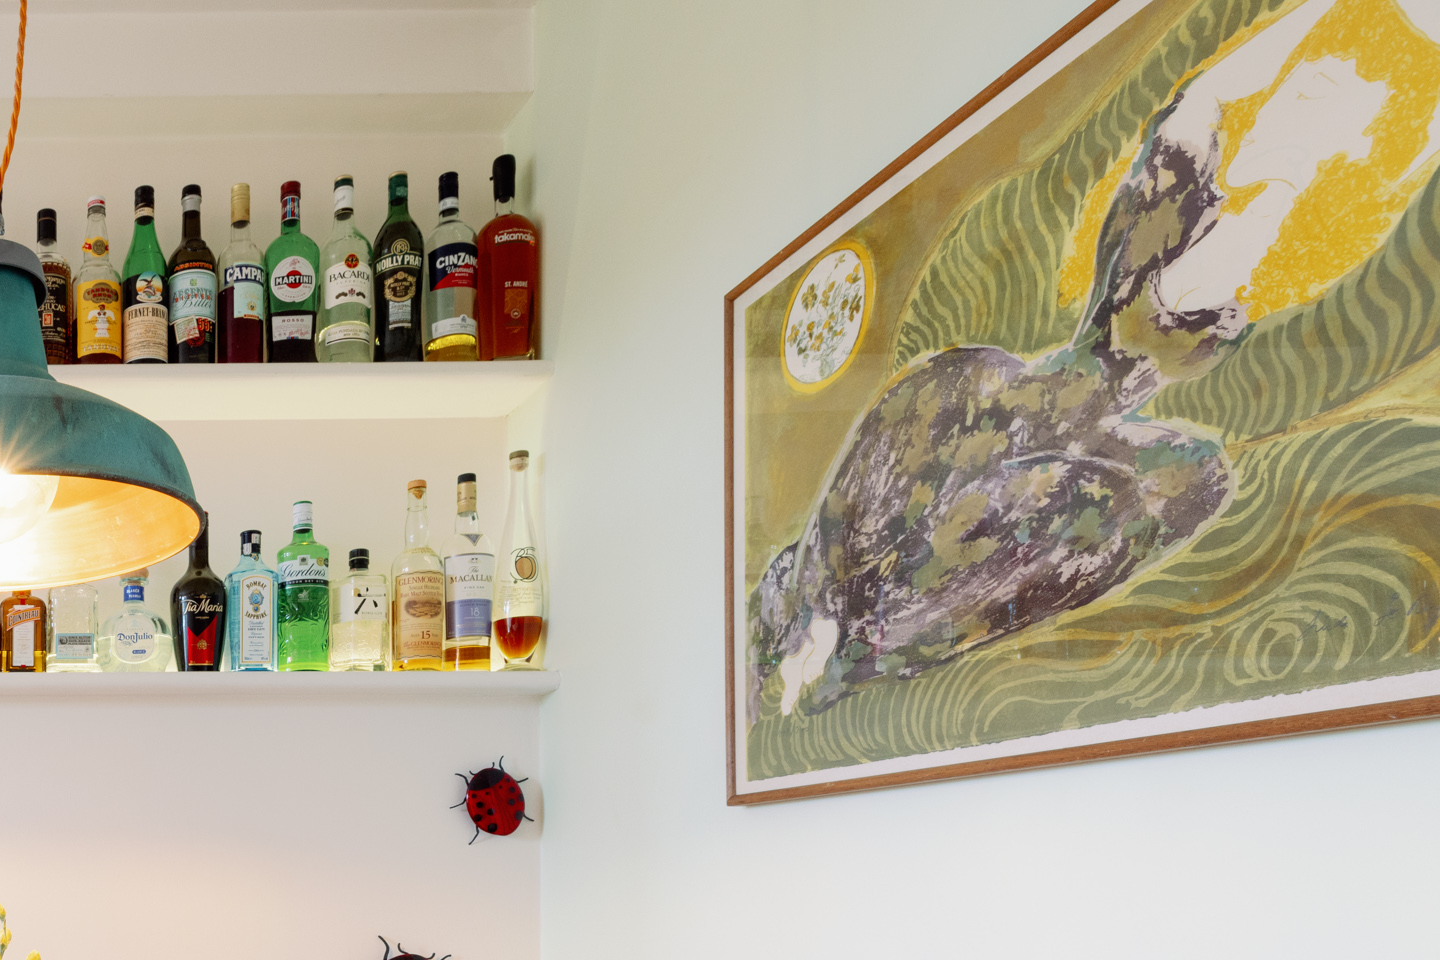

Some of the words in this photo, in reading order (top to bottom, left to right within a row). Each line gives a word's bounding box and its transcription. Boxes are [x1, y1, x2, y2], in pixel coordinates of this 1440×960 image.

[174, 262, 213, 271] ABSINTHE
[376, 255, 402, 273] NOILLY
[404, 254, 422, 268] PRAT
[275, 276, 313, 285] MARTINI
[329, 270, 370, 282] BACARDI
[281, 563, 326, 580] Gordon's
[468, 566, 480, 574] The
[245, 580, 267, 590] BOMBAY
[195, 599, 223, 614] Maria
[245, 610, 268, 620] SAPPHIRE
[470, 608, 480, 616] 18
[8, 609, 39, 628] COINTREAU
[420, 630, 431, 639] 15
